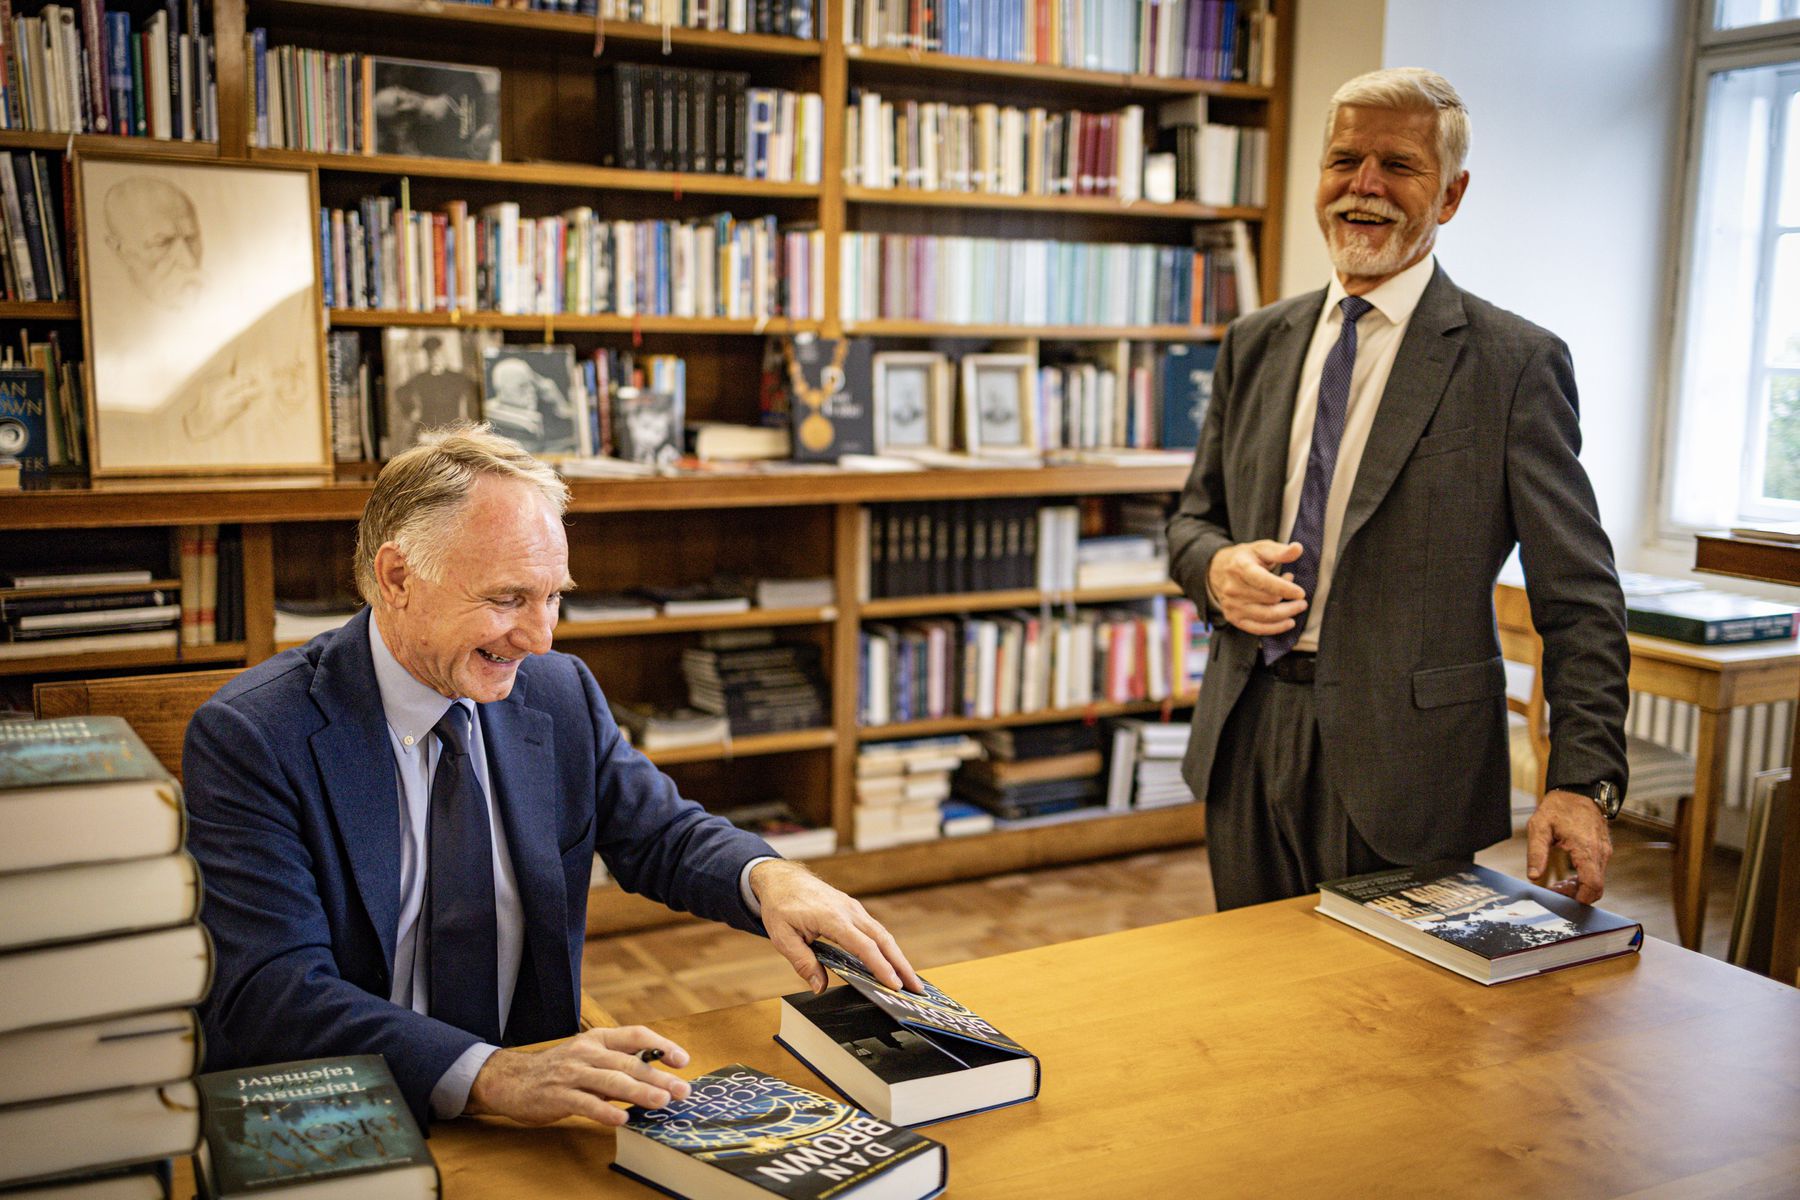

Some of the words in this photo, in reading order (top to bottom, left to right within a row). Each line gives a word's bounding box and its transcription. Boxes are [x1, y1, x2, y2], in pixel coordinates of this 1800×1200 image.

[873, 990, 1000, 1035] BROWN
[918, 1013, 990, 1040] DAN
[238, 1066, 355, 1090] tajemství
[241, 1081, 367, 1107] Tajemství
[644, 1071, 759, 1122] SECRETS
[688, 1076, 789, 1123] SECRET
[717, 1103, 763, 1121] THE
[662, 1119, 693, 1137] OF
[756, 1116, 894, 1184] BROWN
[816, 1142, 896, 1181] DAN
